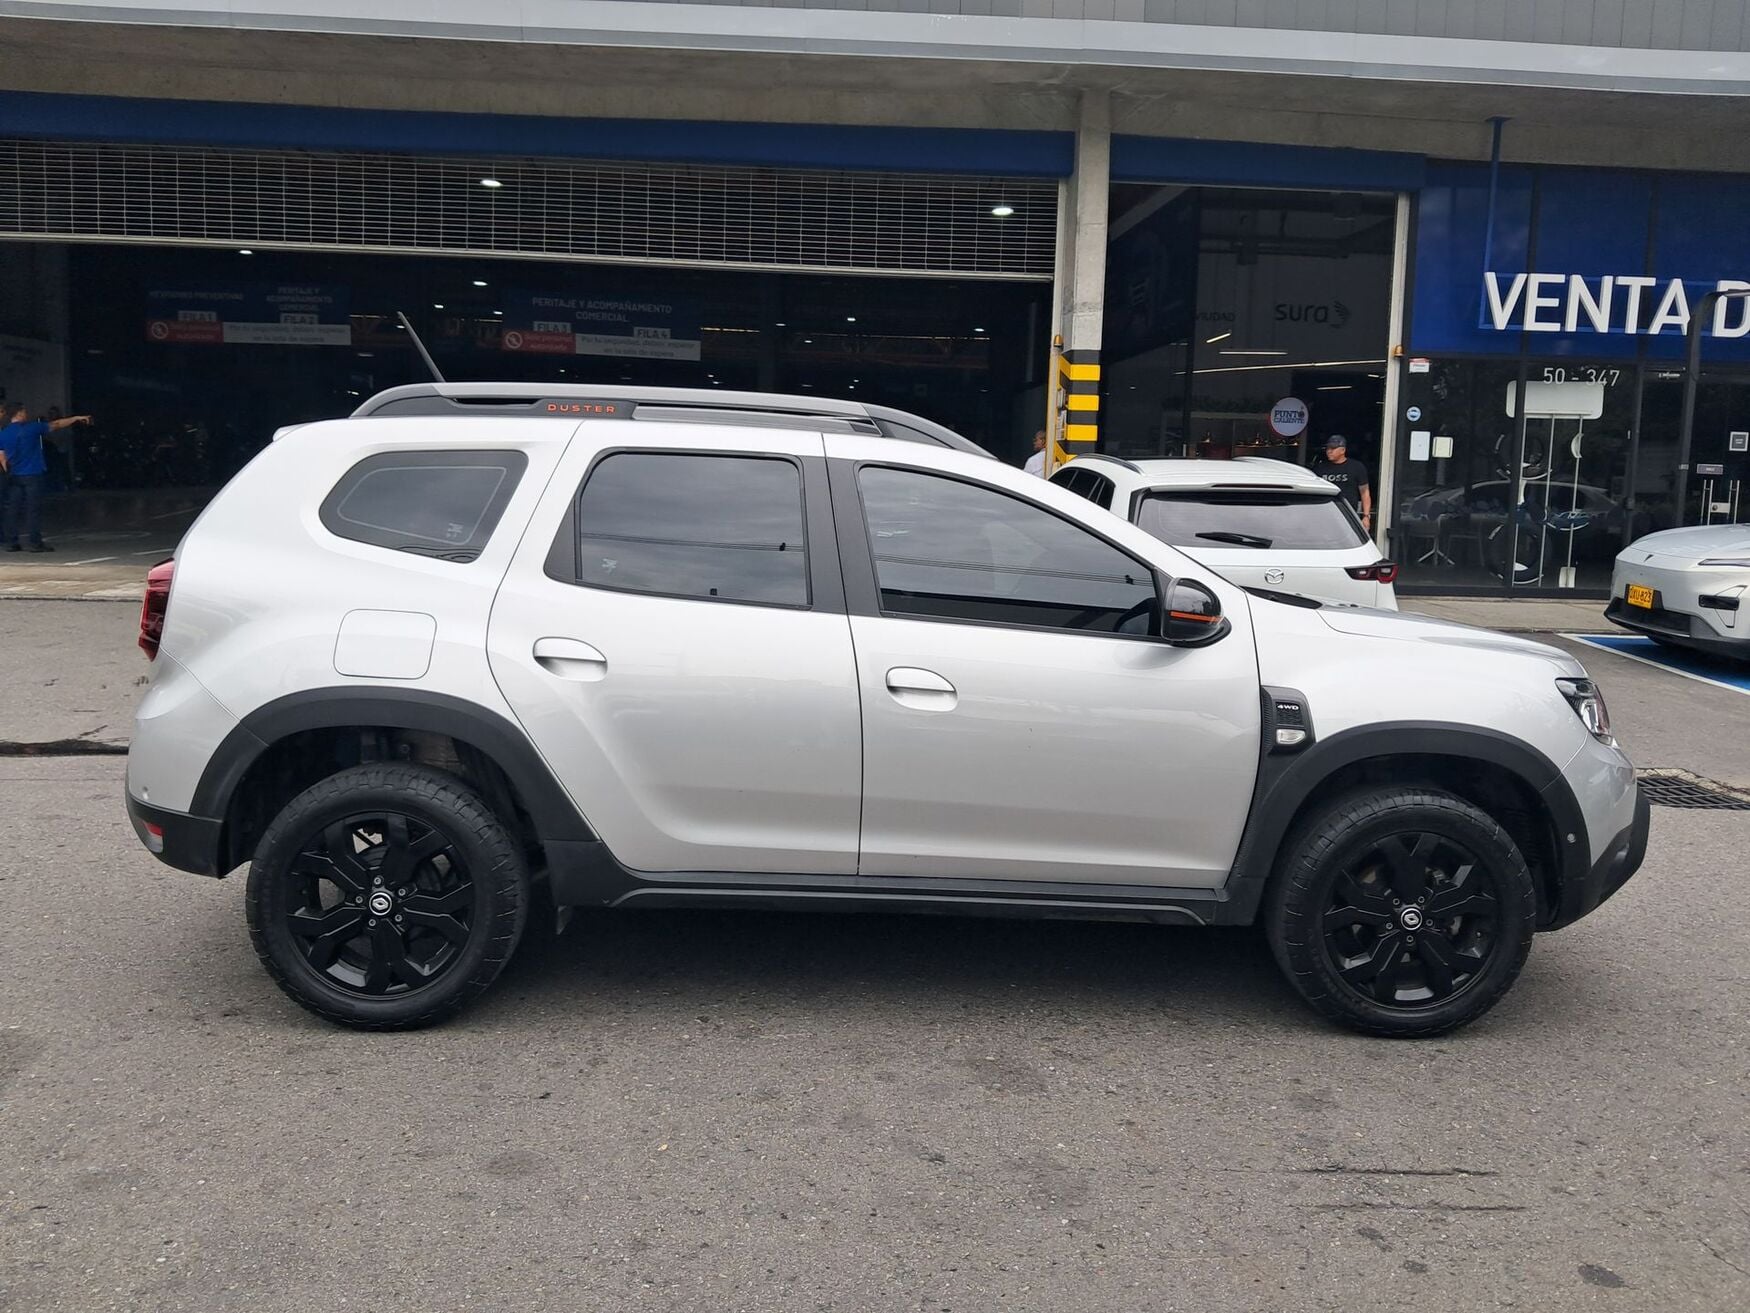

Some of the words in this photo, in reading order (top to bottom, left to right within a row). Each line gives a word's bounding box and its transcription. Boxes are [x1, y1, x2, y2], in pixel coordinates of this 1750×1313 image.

[532, 297, 576, 309] PERITAJE
[578, 300, 585, 309] Y
[587, 300, 672, 315] ACOMPAÑAMIENTO
[1484, 272, 1690, 336] VENTA
[576, 311, 629, 322] COMERCIAL
[1275, 303, 1329, 323] sura
[637, 329, 658, 338] FILA
[1542, 367, 1565, 384] 50
[1585, 369, 1620, 387] 347
[547, 403, 615, 413] DUSTER
[1274, 409, 1305, 418] PUNTO
